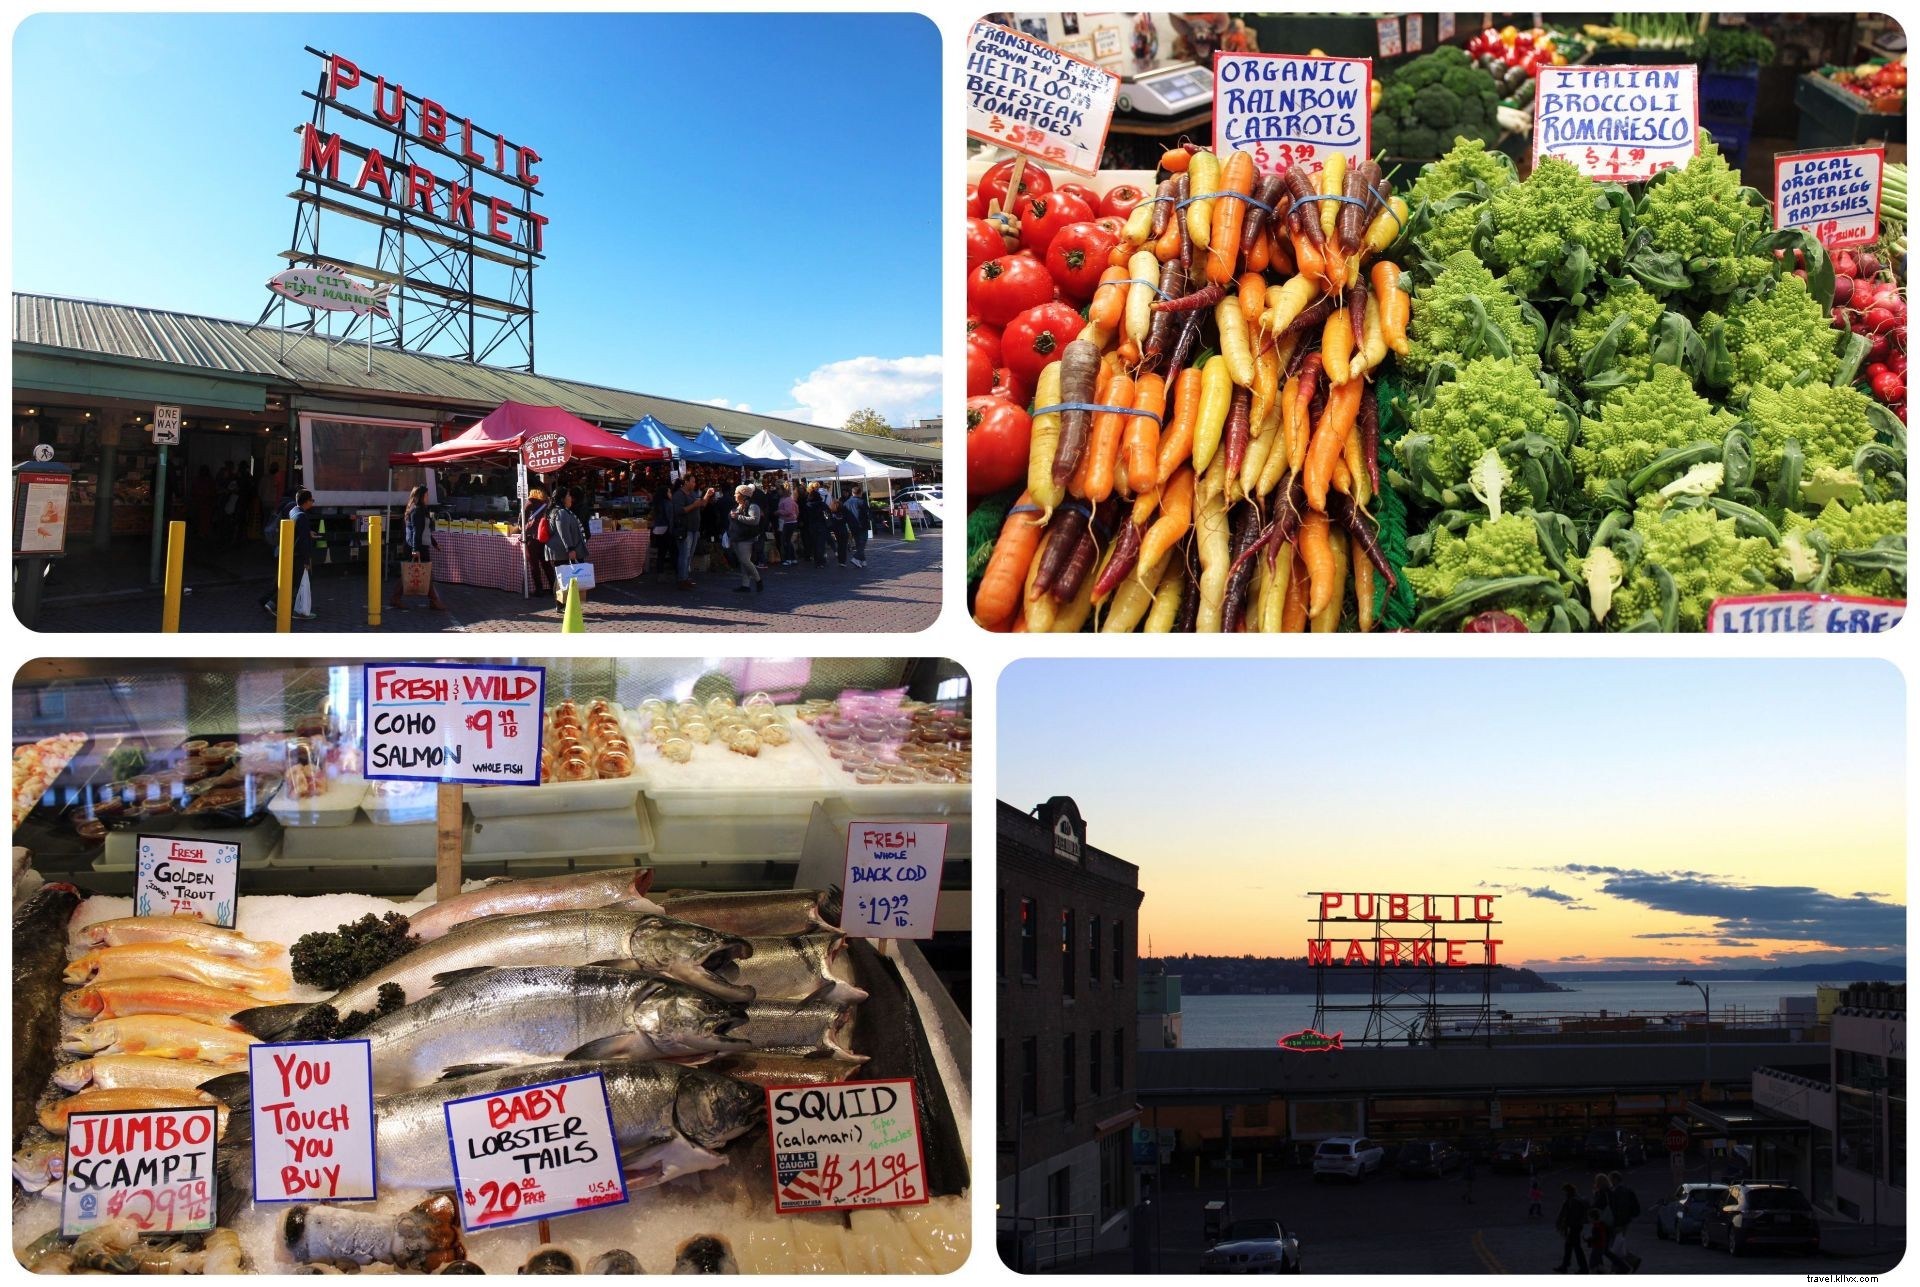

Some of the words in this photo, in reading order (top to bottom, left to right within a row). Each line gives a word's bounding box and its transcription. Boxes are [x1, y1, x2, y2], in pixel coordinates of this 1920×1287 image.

[975, 40, 1028, 65] GROWN
[1031, 60, 1052, 75] IN
[1222, 60, 1356, 84] ORGANIC
[1557, 71, 1680, 88] ITALIAN
[967, 74, 1084, 127] BEEFSTEAK
[1224, 88, 1358, 115] RAINBOW
[1539, 94, 1681, 119] BROCCOLI
[326, 53, 541, 186] PUBLIC
[971, 92, 1072, 137] TOMATOES
[1225, 113, 1356, 140] CARROTS
[1542, 116, 1688, 143] ROMANESCO
[1795, 158, 1853, 175] LOCAL
[300, 122, 549, 252] MARKET
[1782, 167, 1864, 192] ORGANIC
[1783, 180, 1872, 208] EASTEREGG
[1788, 195, 1868, 222] RADISHES
[1835, 226, 1866, 240] BUNCH
[284, 281, 316, 295] FISH
[322, 288, 378, 306] MARKET
[316, 274, 351, 289] CITY
[157, 419, 177, 429] WAY
[158, 409, 177, 418] ONE
[531, 433, 558, 443] ORGANIC
[528, 447, 565, 459] APPLE
[528, 456, 566, 467] CIDER
[1723, 604, 1814, 633] LITTLE
[375, 669, 448, 701] FRESH
[463, 675, 537, 701] WILD
[374, 712, 436, 735] COHO
[503, 726, 518, 737] LB
[372, 743, 461, 768] SALMON
[473, 763, 501, 773] WHOLE
[503, 763, 523, 774] FISH
[171, 842, 203, 858] FRESH
[864, 831, 916, 850] FRESH
[874, 850, 907, 860] WHOLE
[154, 862, 214, 885] GOLDEN
[851, 866, 893, 883] BLACK
[897, 865, 927, 882] COD
[174, 886, 216, 900] TROUT
[1321, 892, 1495, 921] PUBLIC
[1308, 939, 1504, 966] MARKET
[487, 1085, 567, 1129] BABY
[775, 1086, 897, 1125] SQUID
[70, 1115, 211, 1157] JUMBO
[468, 1116, 588, 1159] LOBSTER
[776, 1125, 862, 1149] (calamari)
[1666, 1135, 1687, 1146] STOP
[513, 1140, 598, 1174] TAILS
[779, 1153, 815, 1162] WILD
[779, 1161, 815, 1170] CAUGHT
[69, 1152, 206, 1192] SCAMPI
[281, 1164, 340, 1197] BUY
[523, 1191, 546, 1205] EACH
